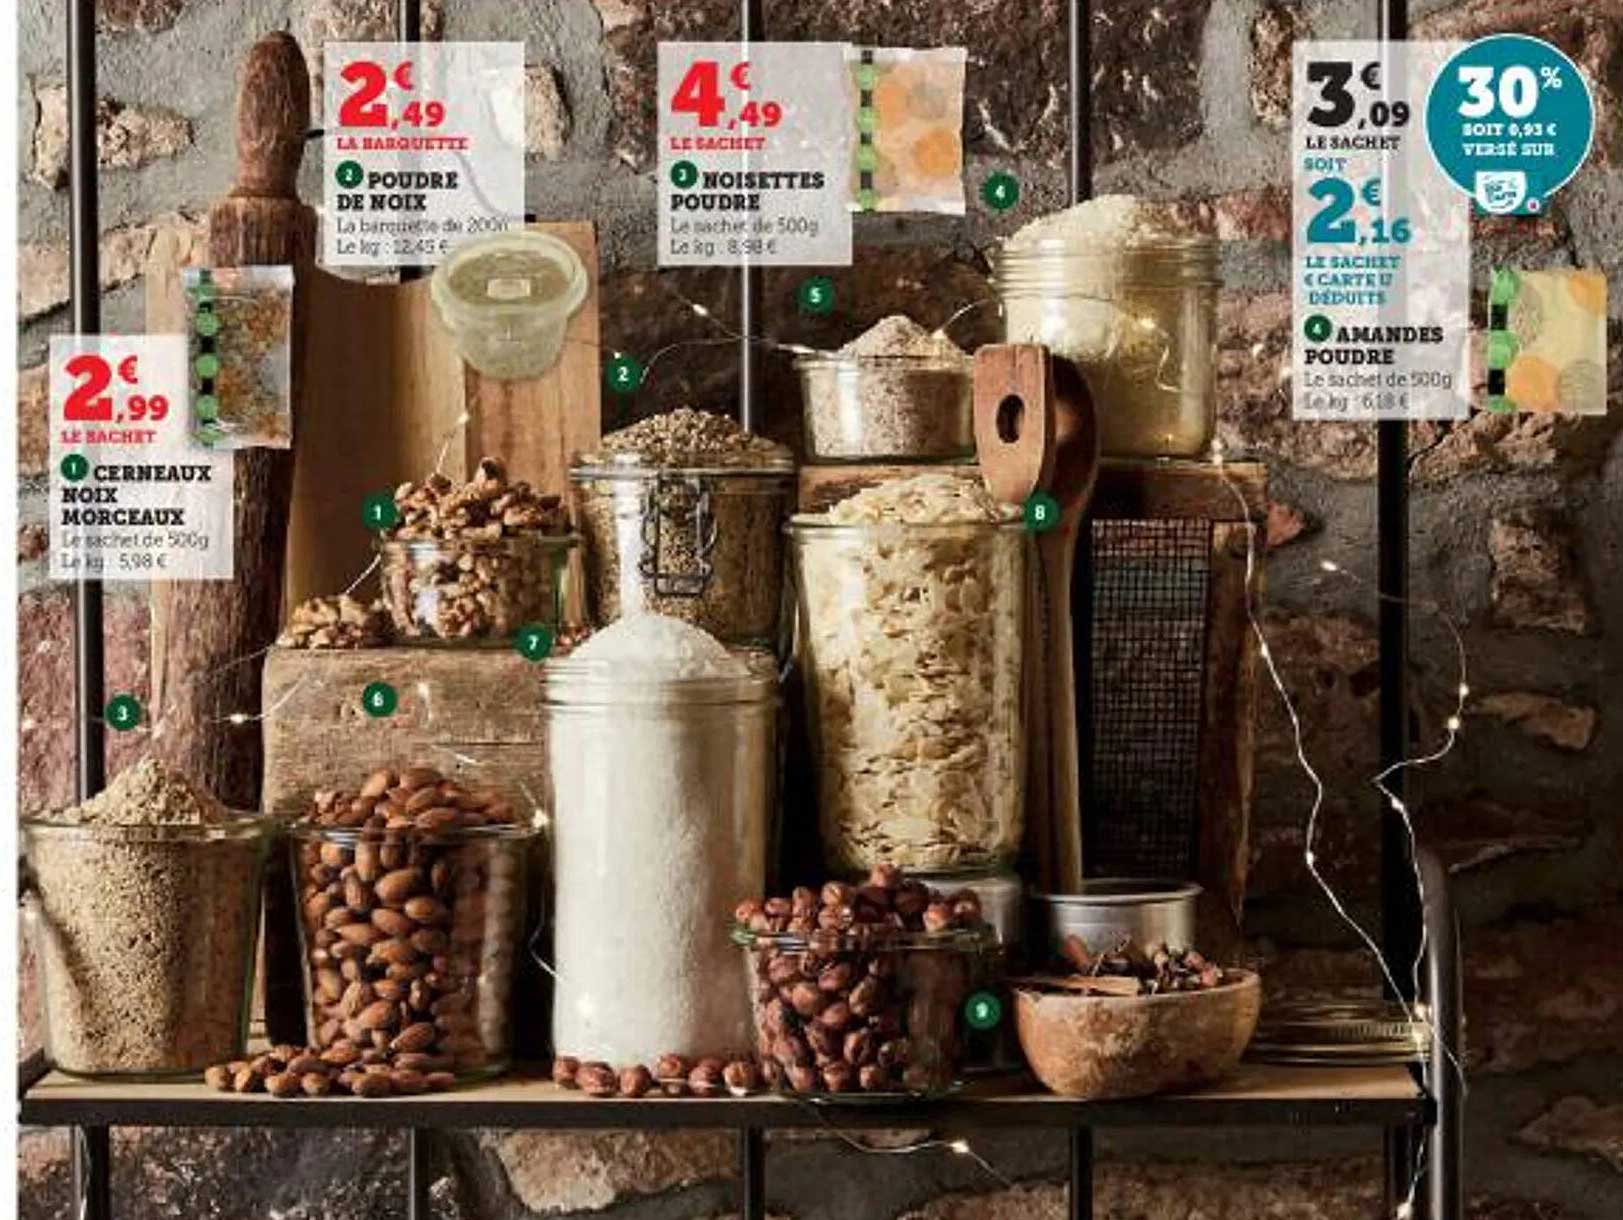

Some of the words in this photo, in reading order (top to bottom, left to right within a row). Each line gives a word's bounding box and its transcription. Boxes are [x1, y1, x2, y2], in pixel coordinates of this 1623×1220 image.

[1462, 123, 1503, 136] SOIT
[337, 137, 358, 150] LA
[363, 137, 468, 150] BARQUETTE
[670, 137, 691, 150] LE
[696, 137, 765, 150] SACHET
[1306, 136, 1327, 150] LE
[1330, 136, 1401, 150] SACHET
[1521, 143, 1554, 156] SUR
[1304, 158, 1347, 171] SOIT
[368, 171, 458, 189] POUDRE
[703, 172, 825, 189] NOISETTES
[337, 194, 363, 211] DE
[369, 194, 427, 211] NOIX
[671, 194, 760, 211] POUDRE
[336, 217, 356, 233] La
[360, 217, 438, 236] barquette
[442, 217, 462, 233] de
[671, 217, 689, 233] Le
[694, 217, 748, 233] sachet
[752, 217, 774, 233] de
[777, 216, 819, 237] 500g
[337, 239, 356, 255] Le
[360, 239, 381, 257] kg
[671, 239, 689, 255] Le
[694, 239, 714, 257] kg
[1306, 256, 1326, 268] LE
[1330, 256, 1400, 268] SACHET
[1319, 274, 1376, 286] CARTE
[1380, 274, 1393, 286] U
[1336, 327, 1444, 343] AMANDES
[1304, 349, 1395, 365] POUDRE
[1304, 371, 1324, 387] Le
[1328, 371, 1381, 387] sachet
[1386, 371, 1406, 387] de
[61, 431, 82, 444] LE
[86, 431, 157, 444] SACHET
[94, 465, 212, 481] CERNEAUX
[61, 488, 118, 503] NOIX
[61, 509, 185, 526] MORCEAUX
[61, 533, 82, 548] Le
[85, 533, 139, 548] sachet
[142, 533, 163, 548] de
[168, 532, 208, 550] 500g
[61, 553, 81, 568] Le
[119, 553, 152, 570] 5,98
